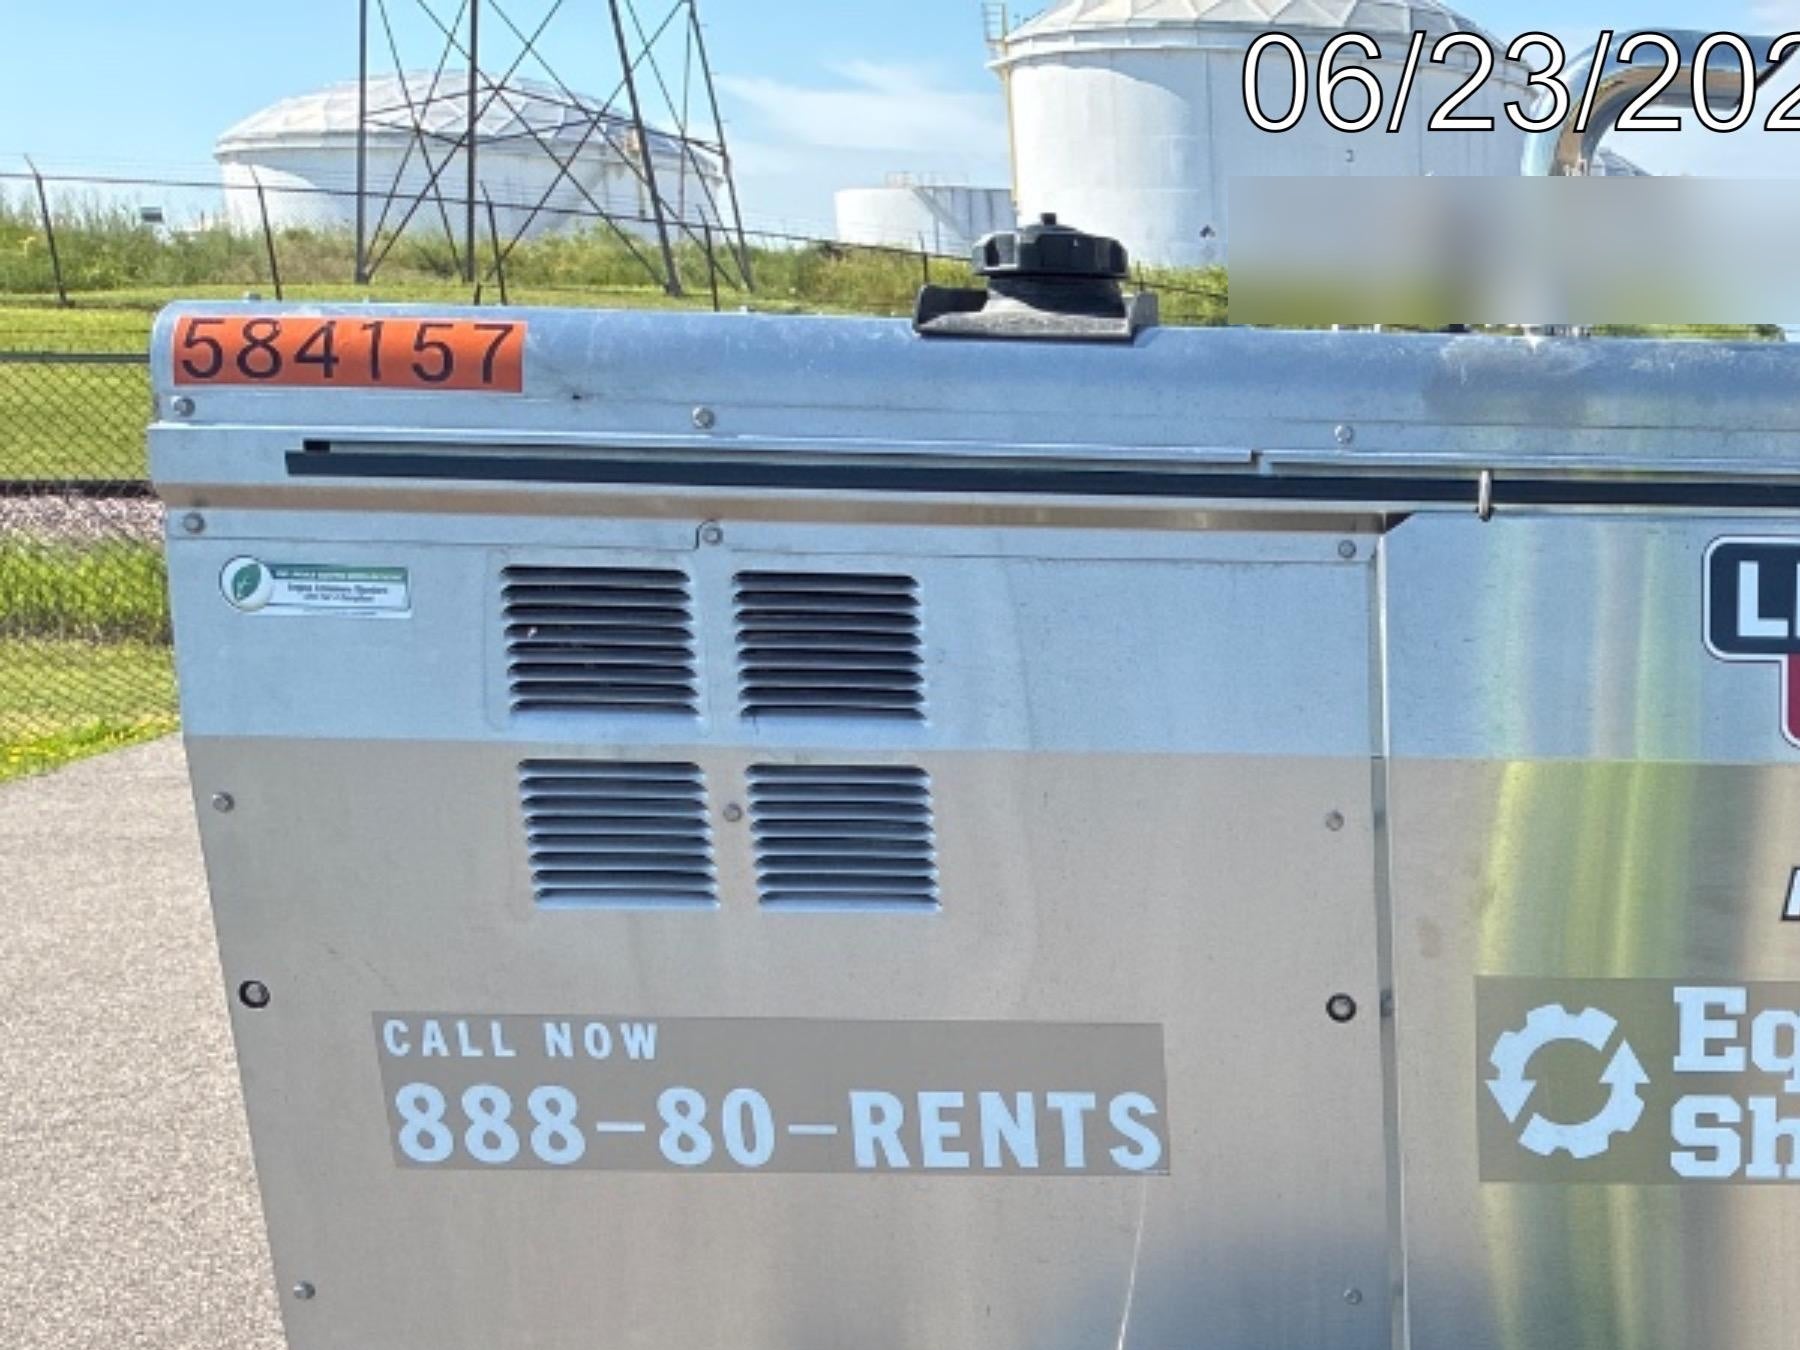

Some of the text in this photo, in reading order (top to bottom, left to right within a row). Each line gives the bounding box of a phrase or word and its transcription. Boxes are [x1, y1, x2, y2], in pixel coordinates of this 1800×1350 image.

[181, 317, 517, 385] 584157
[382, 1019, 660, 1061] CALL NOW
[395, 1081, 1165, 1170] 888-80-RENTS
